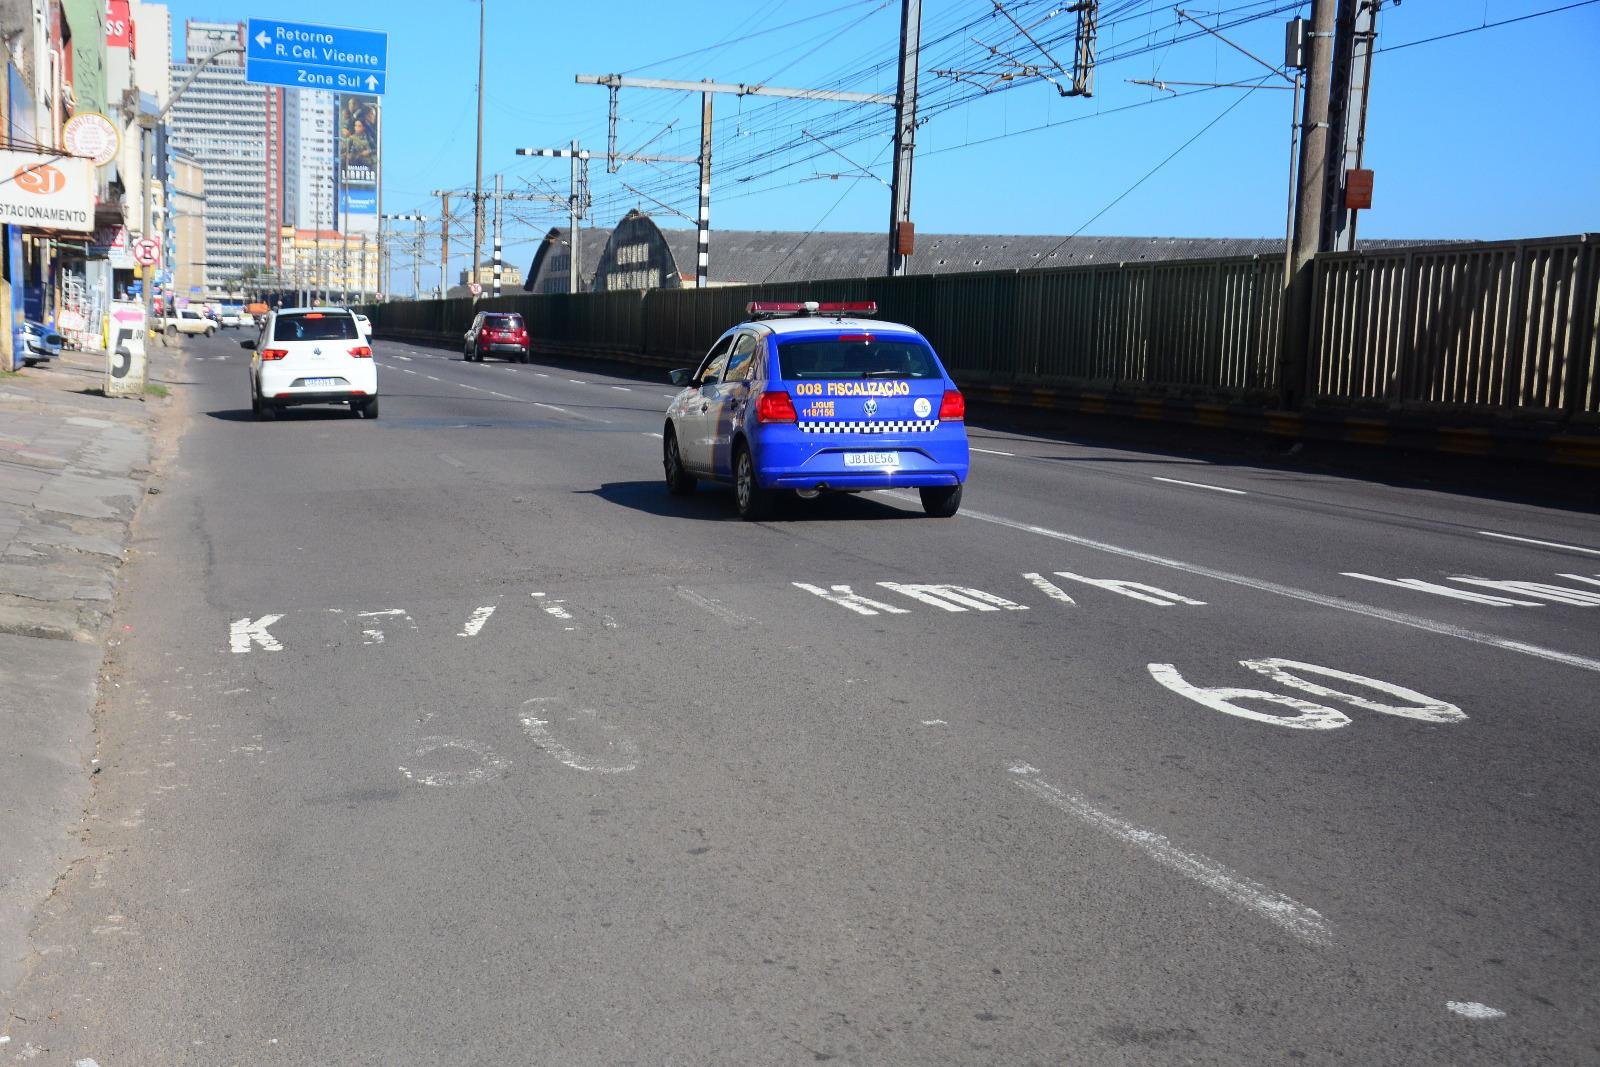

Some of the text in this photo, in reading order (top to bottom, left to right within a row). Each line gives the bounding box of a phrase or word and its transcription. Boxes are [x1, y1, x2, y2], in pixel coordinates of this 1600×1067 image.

[276, 26, 334, 45] Retorno
[275, 43, 379, 66] R. Cel. Vicente
[297, 69, 360, 87] Zona Sul
[21, 163, 57, 193] SJ
[796, 381, 910, 397] 008 FISCALIZAÇÃO
[802, 408, 835, 417] 118/156
[811, 401, 835, 409] LIGUE
[1147, 657, 1470, 730] 60
